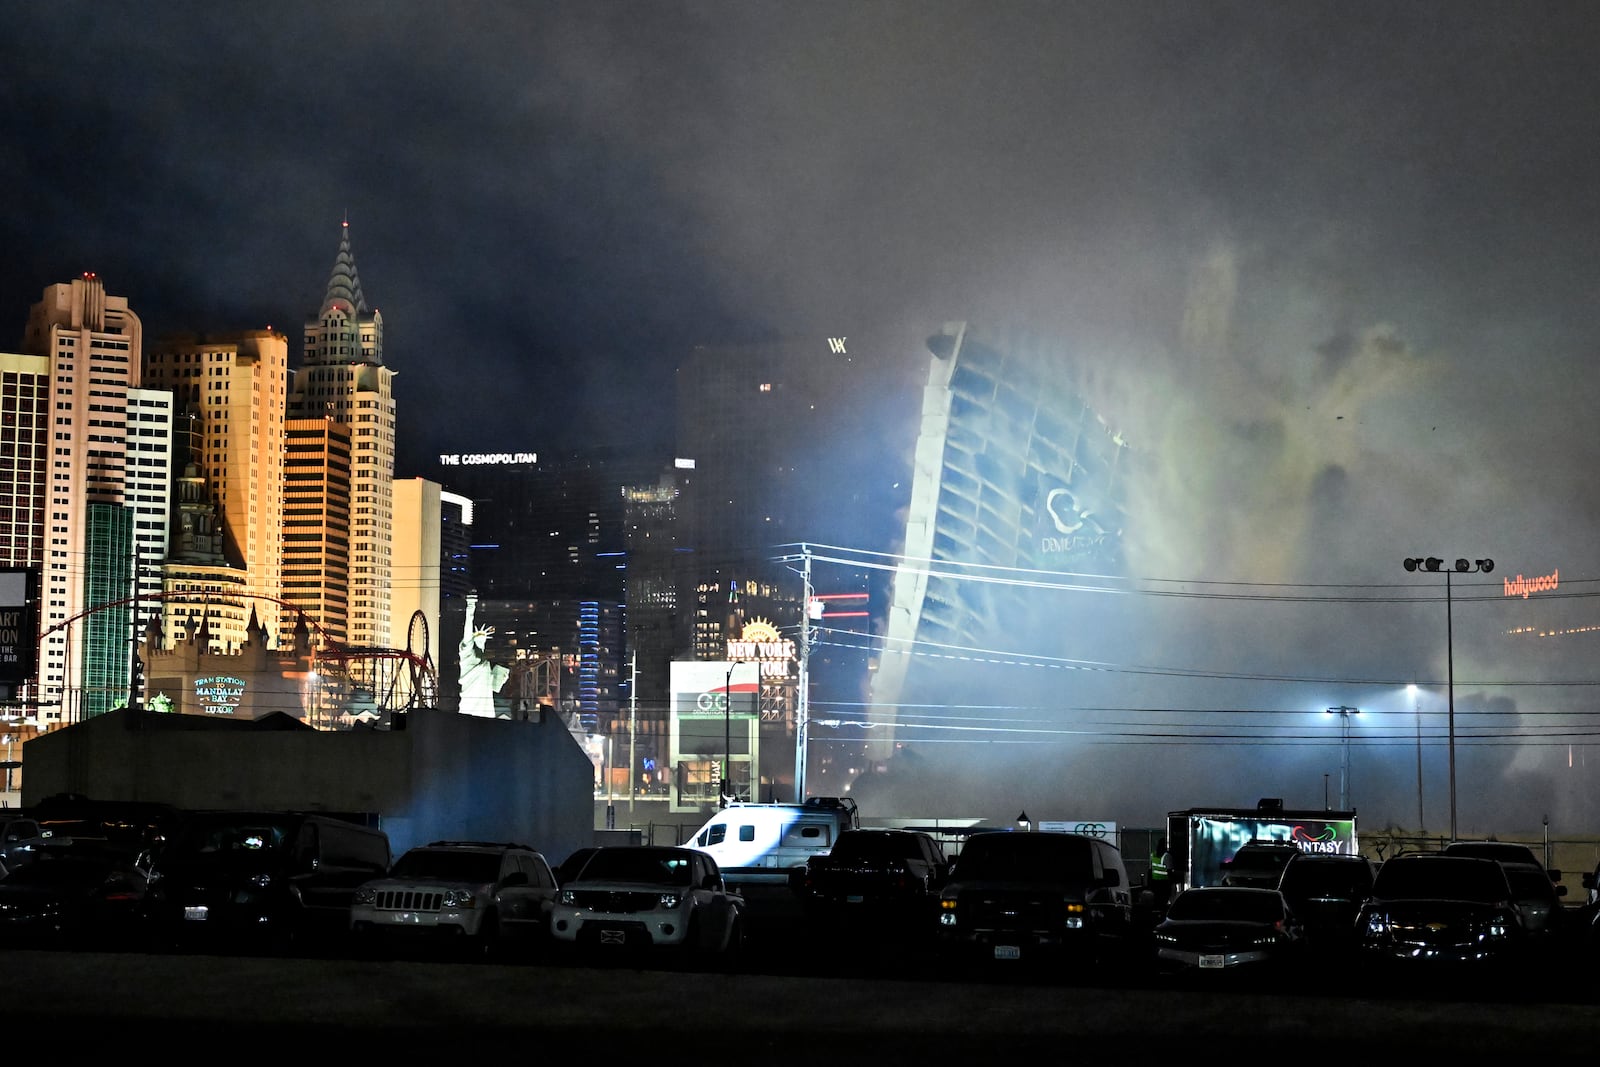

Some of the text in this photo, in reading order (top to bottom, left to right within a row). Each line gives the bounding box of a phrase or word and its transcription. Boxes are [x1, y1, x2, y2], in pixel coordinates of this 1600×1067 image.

[440, 453, 537, 465] THE COSMOPOLITAN
[1504, 568, 1559, 599] hollywood
[727, 642, 793, 658] NEW YORK
[195, 676, 246, 686] TRAM STATION
[196, 687, 244, 696] MANDALAY
[205, 706, 233, 714] LUXOR
[1292, 839, 1344, 855] ANTASY
